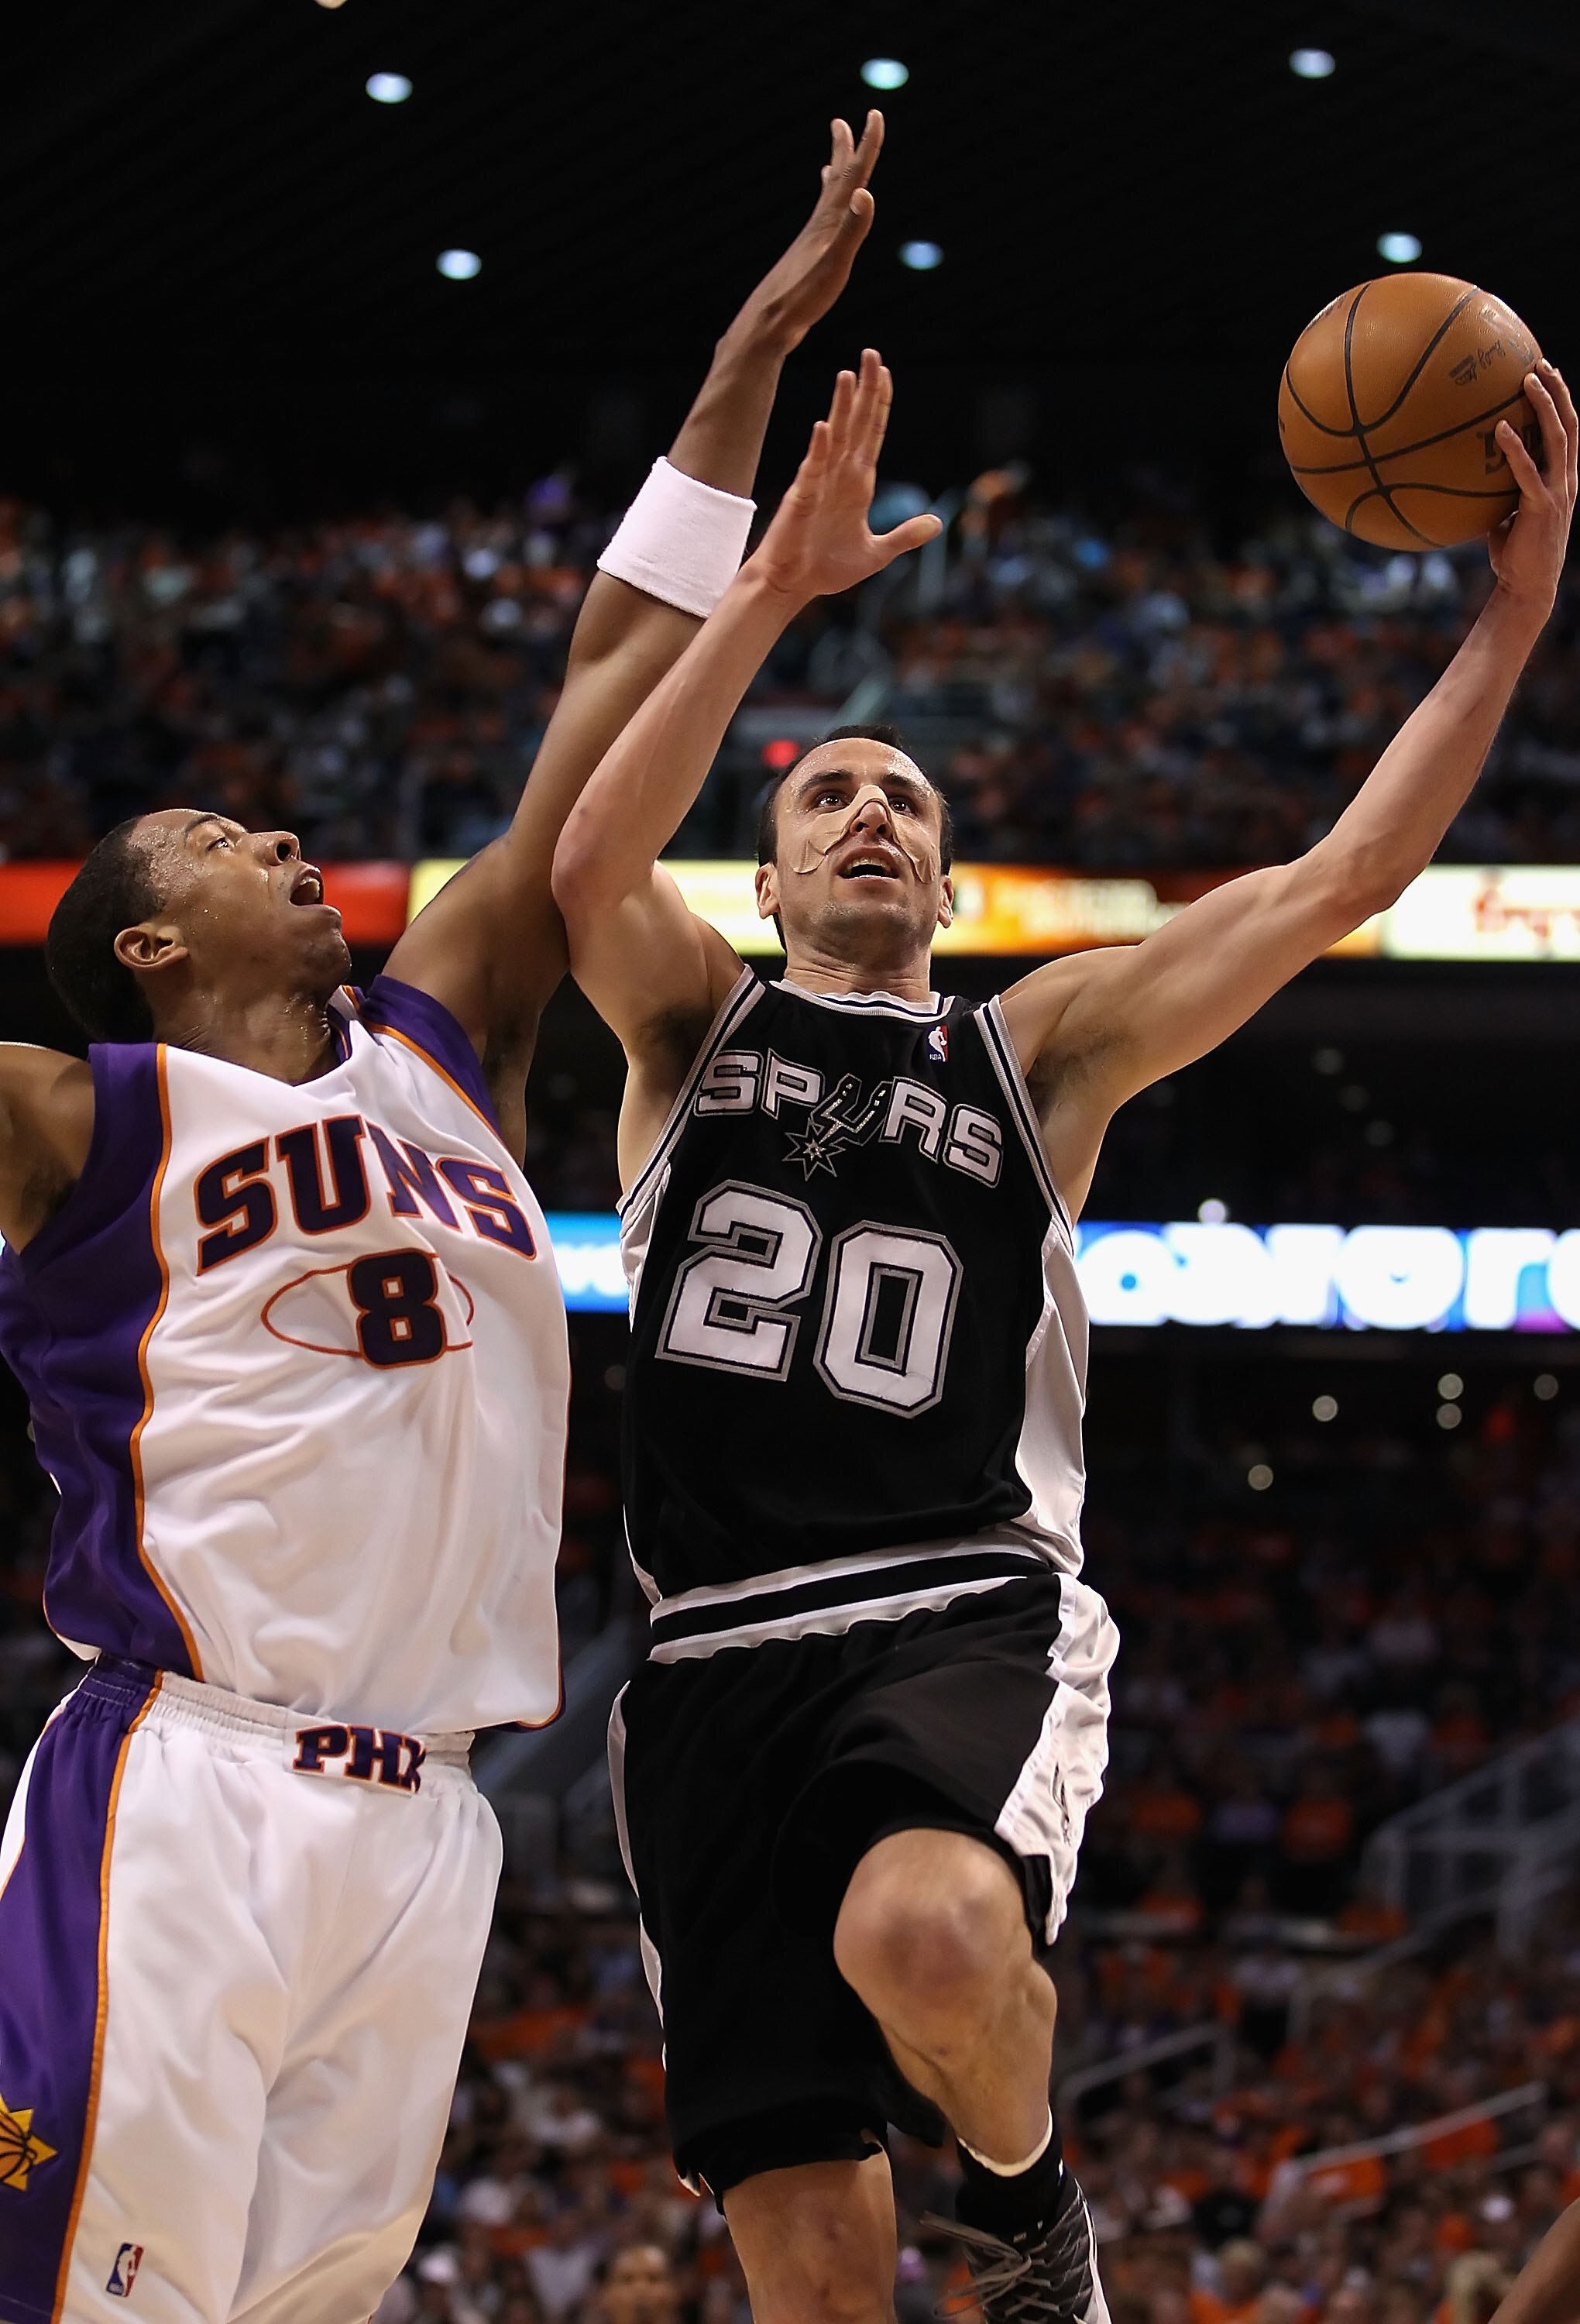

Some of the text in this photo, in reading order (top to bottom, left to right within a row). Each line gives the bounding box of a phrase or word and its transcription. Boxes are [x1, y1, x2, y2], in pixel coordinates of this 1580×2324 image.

[693, 1048, 1004, 1188] SPURS
[193, 1114, 538, 1277] SUNS
[346, 1247, 448, 1370] 8
[654, 1179, 963, 1420] 20
